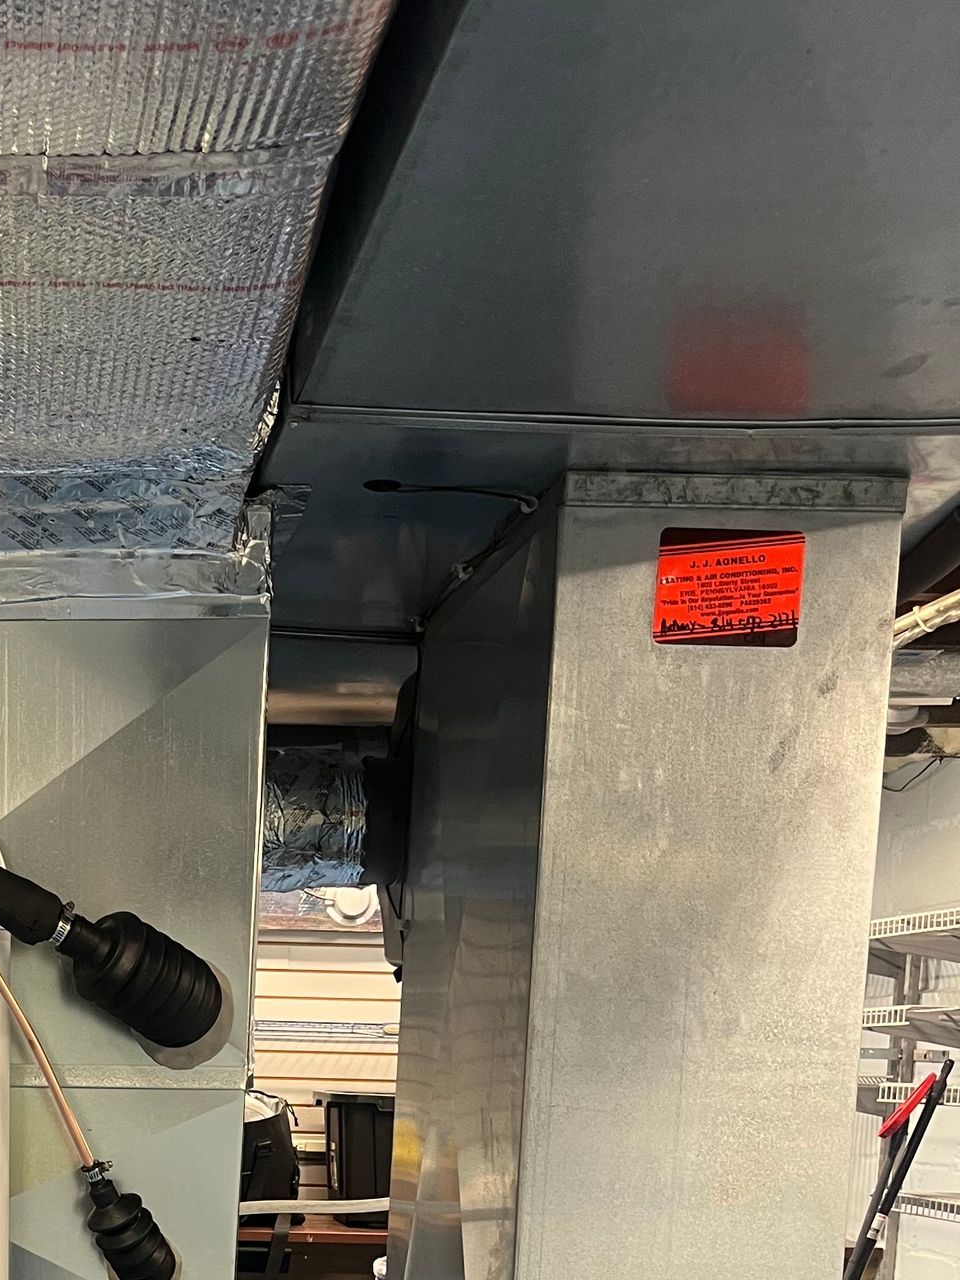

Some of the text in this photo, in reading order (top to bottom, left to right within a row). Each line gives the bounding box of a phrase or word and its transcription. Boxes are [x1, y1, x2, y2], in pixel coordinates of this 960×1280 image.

[690, 555, 766, 569] J. J. AGNELLO
